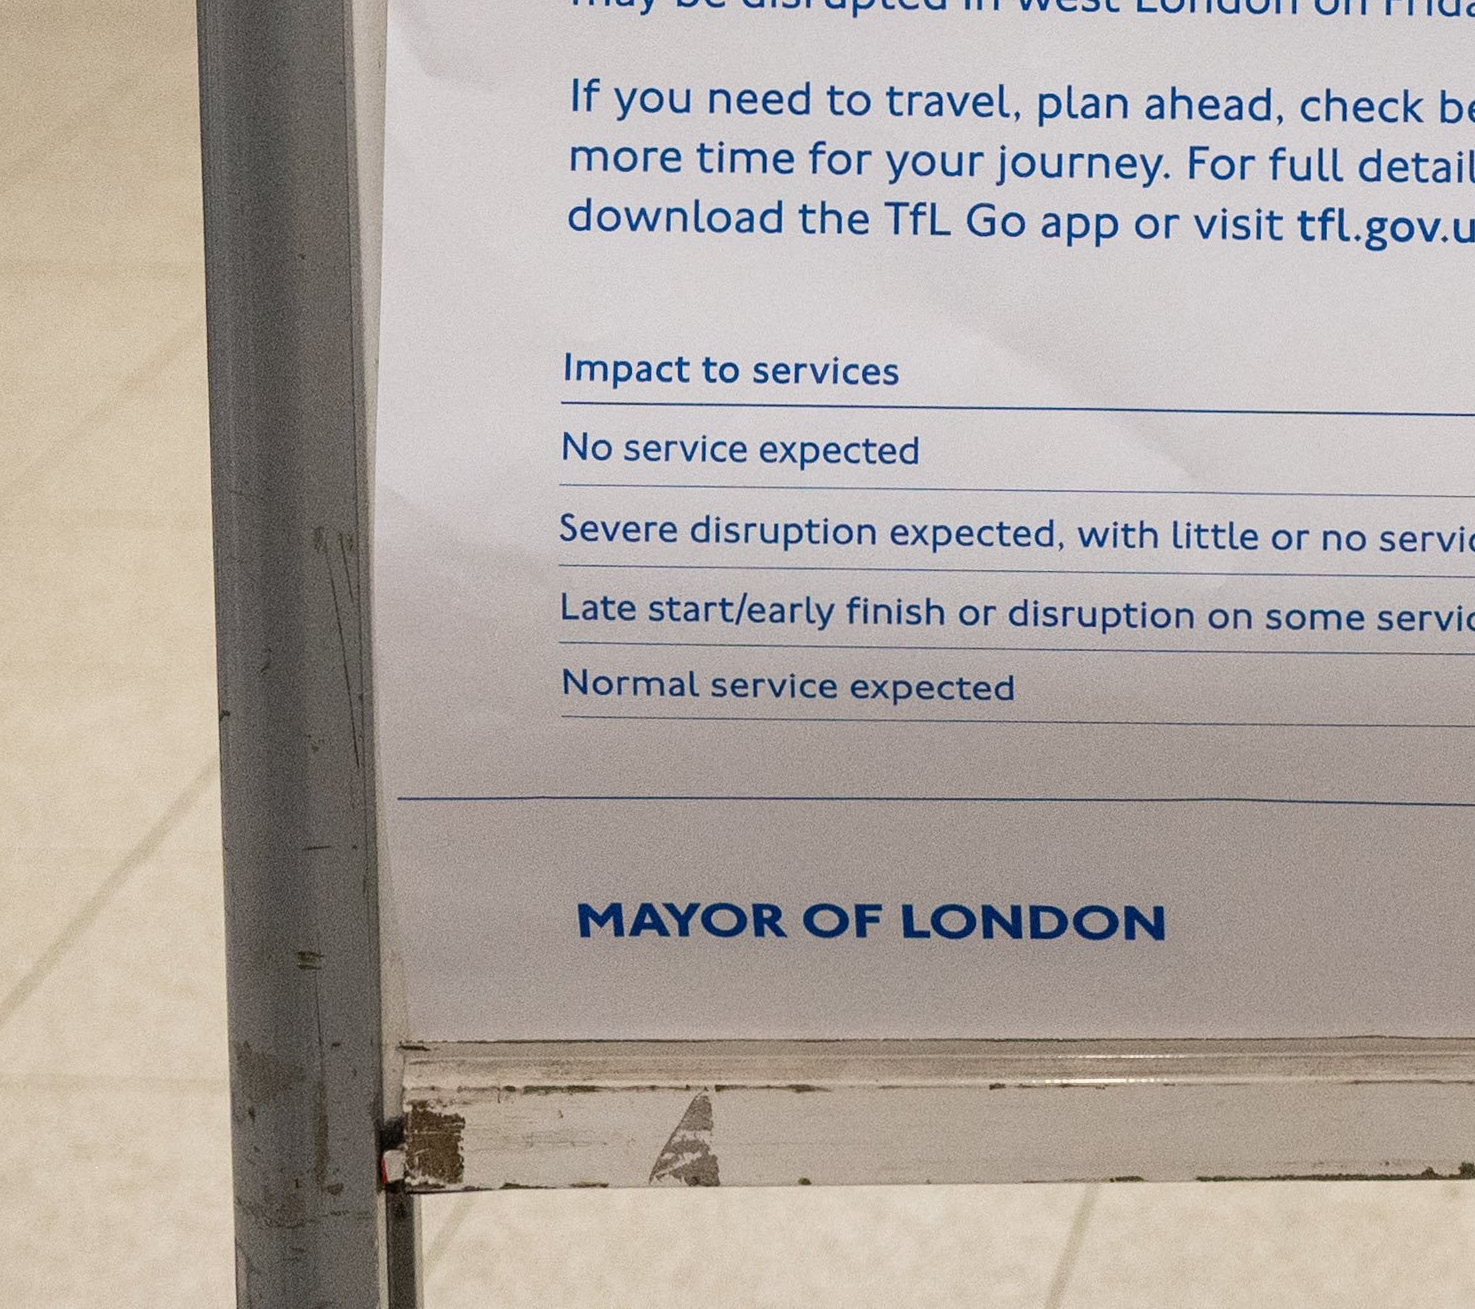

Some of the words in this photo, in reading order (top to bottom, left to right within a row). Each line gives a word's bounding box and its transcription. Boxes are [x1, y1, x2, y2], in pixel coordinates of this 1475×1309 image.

[568, 198, 783, 234] download
[799, 201, 869, 235] the
[886, 201, 949, 236] TfL
[967, 203, 1026, 237] Go
[1041, 212, 1119, 246] app
[1134, 214, 1179, 239] or
[1195, 210, 1283, 241] visit
[565, 352, 689, 389] Impact
[702, 357, 740, 384] to
[753, 360, 899, 385] services
[562, 431, 613, 461] No
[624, 439, 748, 464] service
[759, 437, 919, 470] expected
[560, 513, 677, 543] Severe
[690, 516, 877, 551] disruption
[890, 519, 1064, 553] expected,
[1077, 520, 1159, 549] with
[1172, 520, 1259, 551] little
[1271, 529, 1308, 551] or
[1322, 529, 1367, 551] no
[562, 593, 637, 621] Late
[648, 594, 835, 630] start/early
[846, 595, 946, 626] finish
[958, 604, 995, 627] or
[1008, 599, 1195, 634] disruption
[1208, 608, 1252, 629] on
[1266, 608, 1365, 631] some
[562, 668, 699, 698] Normal
[711, 676, 837, 699] service
[850, 675, 1016, 705] expected
[578, 903, 786, 938] MAYOR
[803, 903, 883, 938] OF
[901, 904, 1165, 941] LONDON
